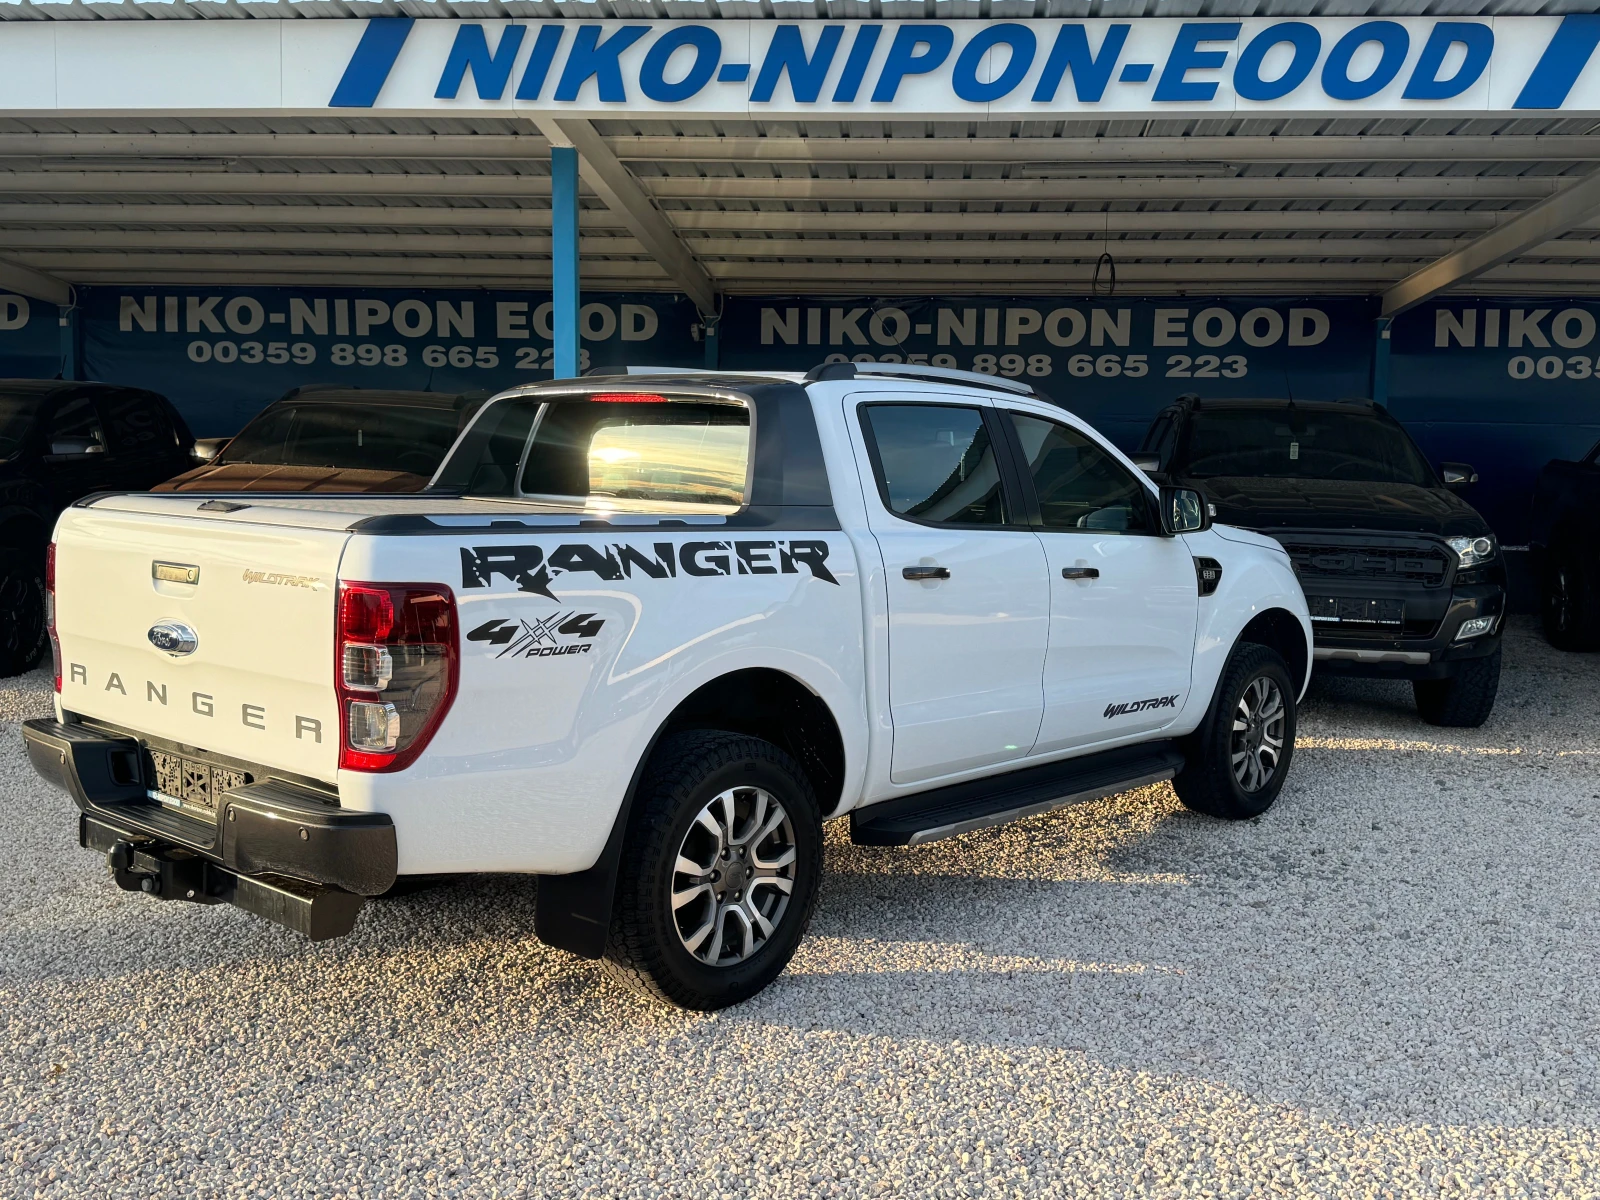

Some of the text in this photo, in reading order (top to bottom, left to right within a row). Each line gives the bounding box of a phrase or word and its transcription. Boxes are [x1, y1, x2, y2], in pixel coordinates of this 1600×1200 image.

[434, 20, 1495, 103] NIKO-NIPON-EOOD
[119, 295, 475, 339] NIKO-NIPON
[760, 307, 1330, 347] NIKO-NIPON EOOD
[1434, 308, 1597, 349] NIKO
[187, 341, 316, 365] 00359
[331, 344, 408, 367] 898
[422, 346, 499, 370] 665
[972, 354, 1053, 377] 898
[1067, 354, 1149, 378] 665
[1165, 355, 1248, 378] 223
[1507, 355, 1600, 380] 003
[242, 568, 320, 591] WILDTRAK
[460, 540, 841, 603] RANGER
[525, 643, 592, 659] POWER
[70, 662, 322, 744] RANGER
[1103, 693, 1180, 719] WILDTRAK
